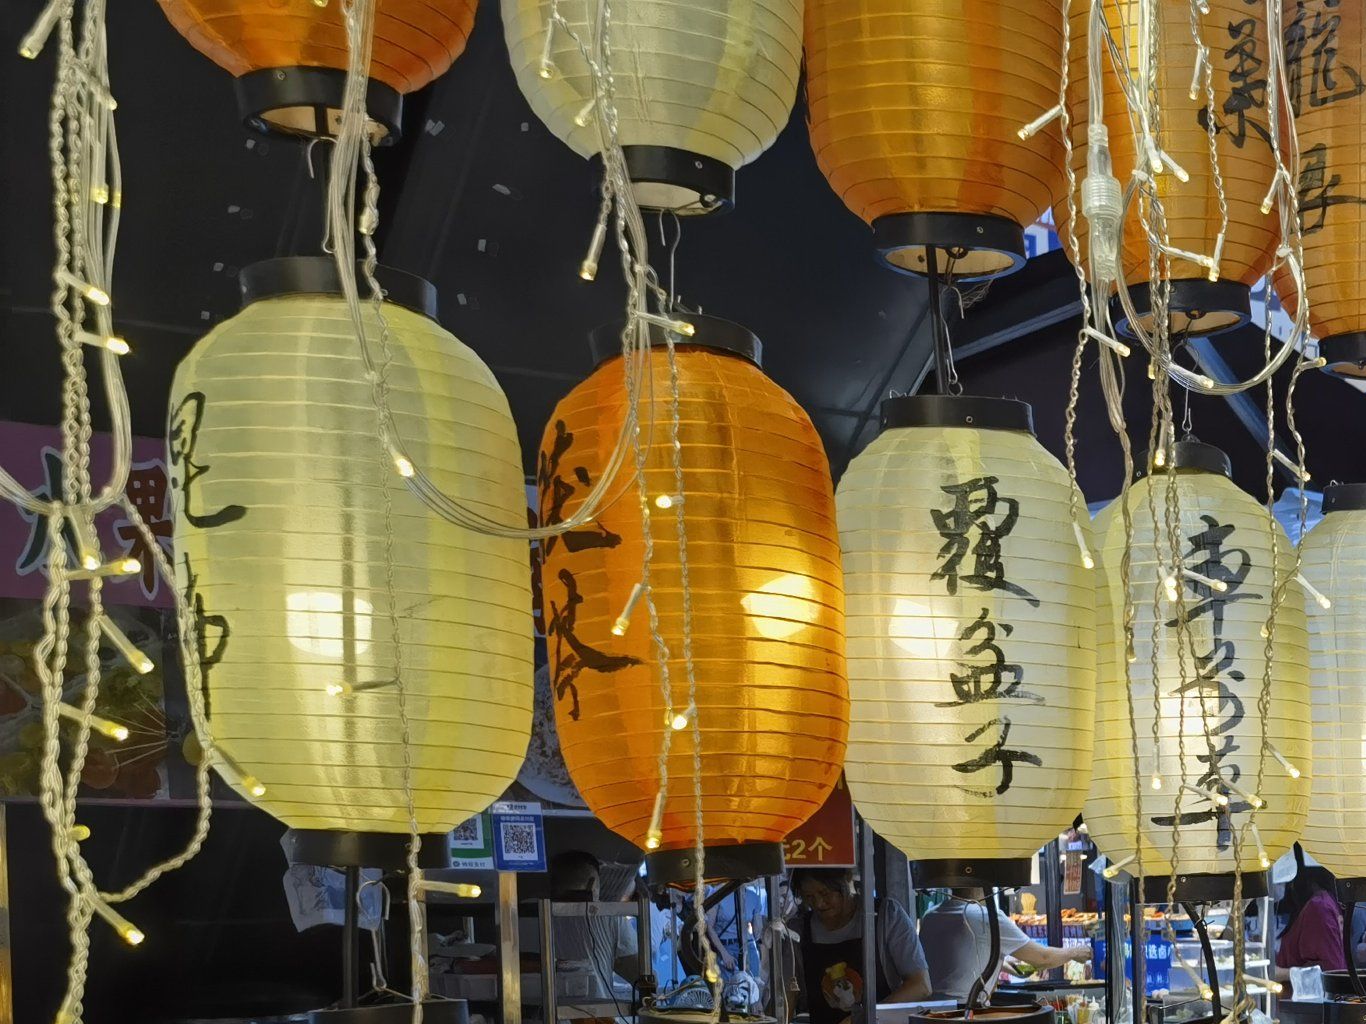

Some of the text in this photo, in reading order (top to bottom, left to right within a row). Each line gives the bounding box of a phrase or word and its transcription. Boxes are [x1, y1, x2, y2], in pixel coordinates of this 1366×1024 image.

[16, 446, 172, 601] 水果
[929, 475, 1045, 798] 覆盆子
